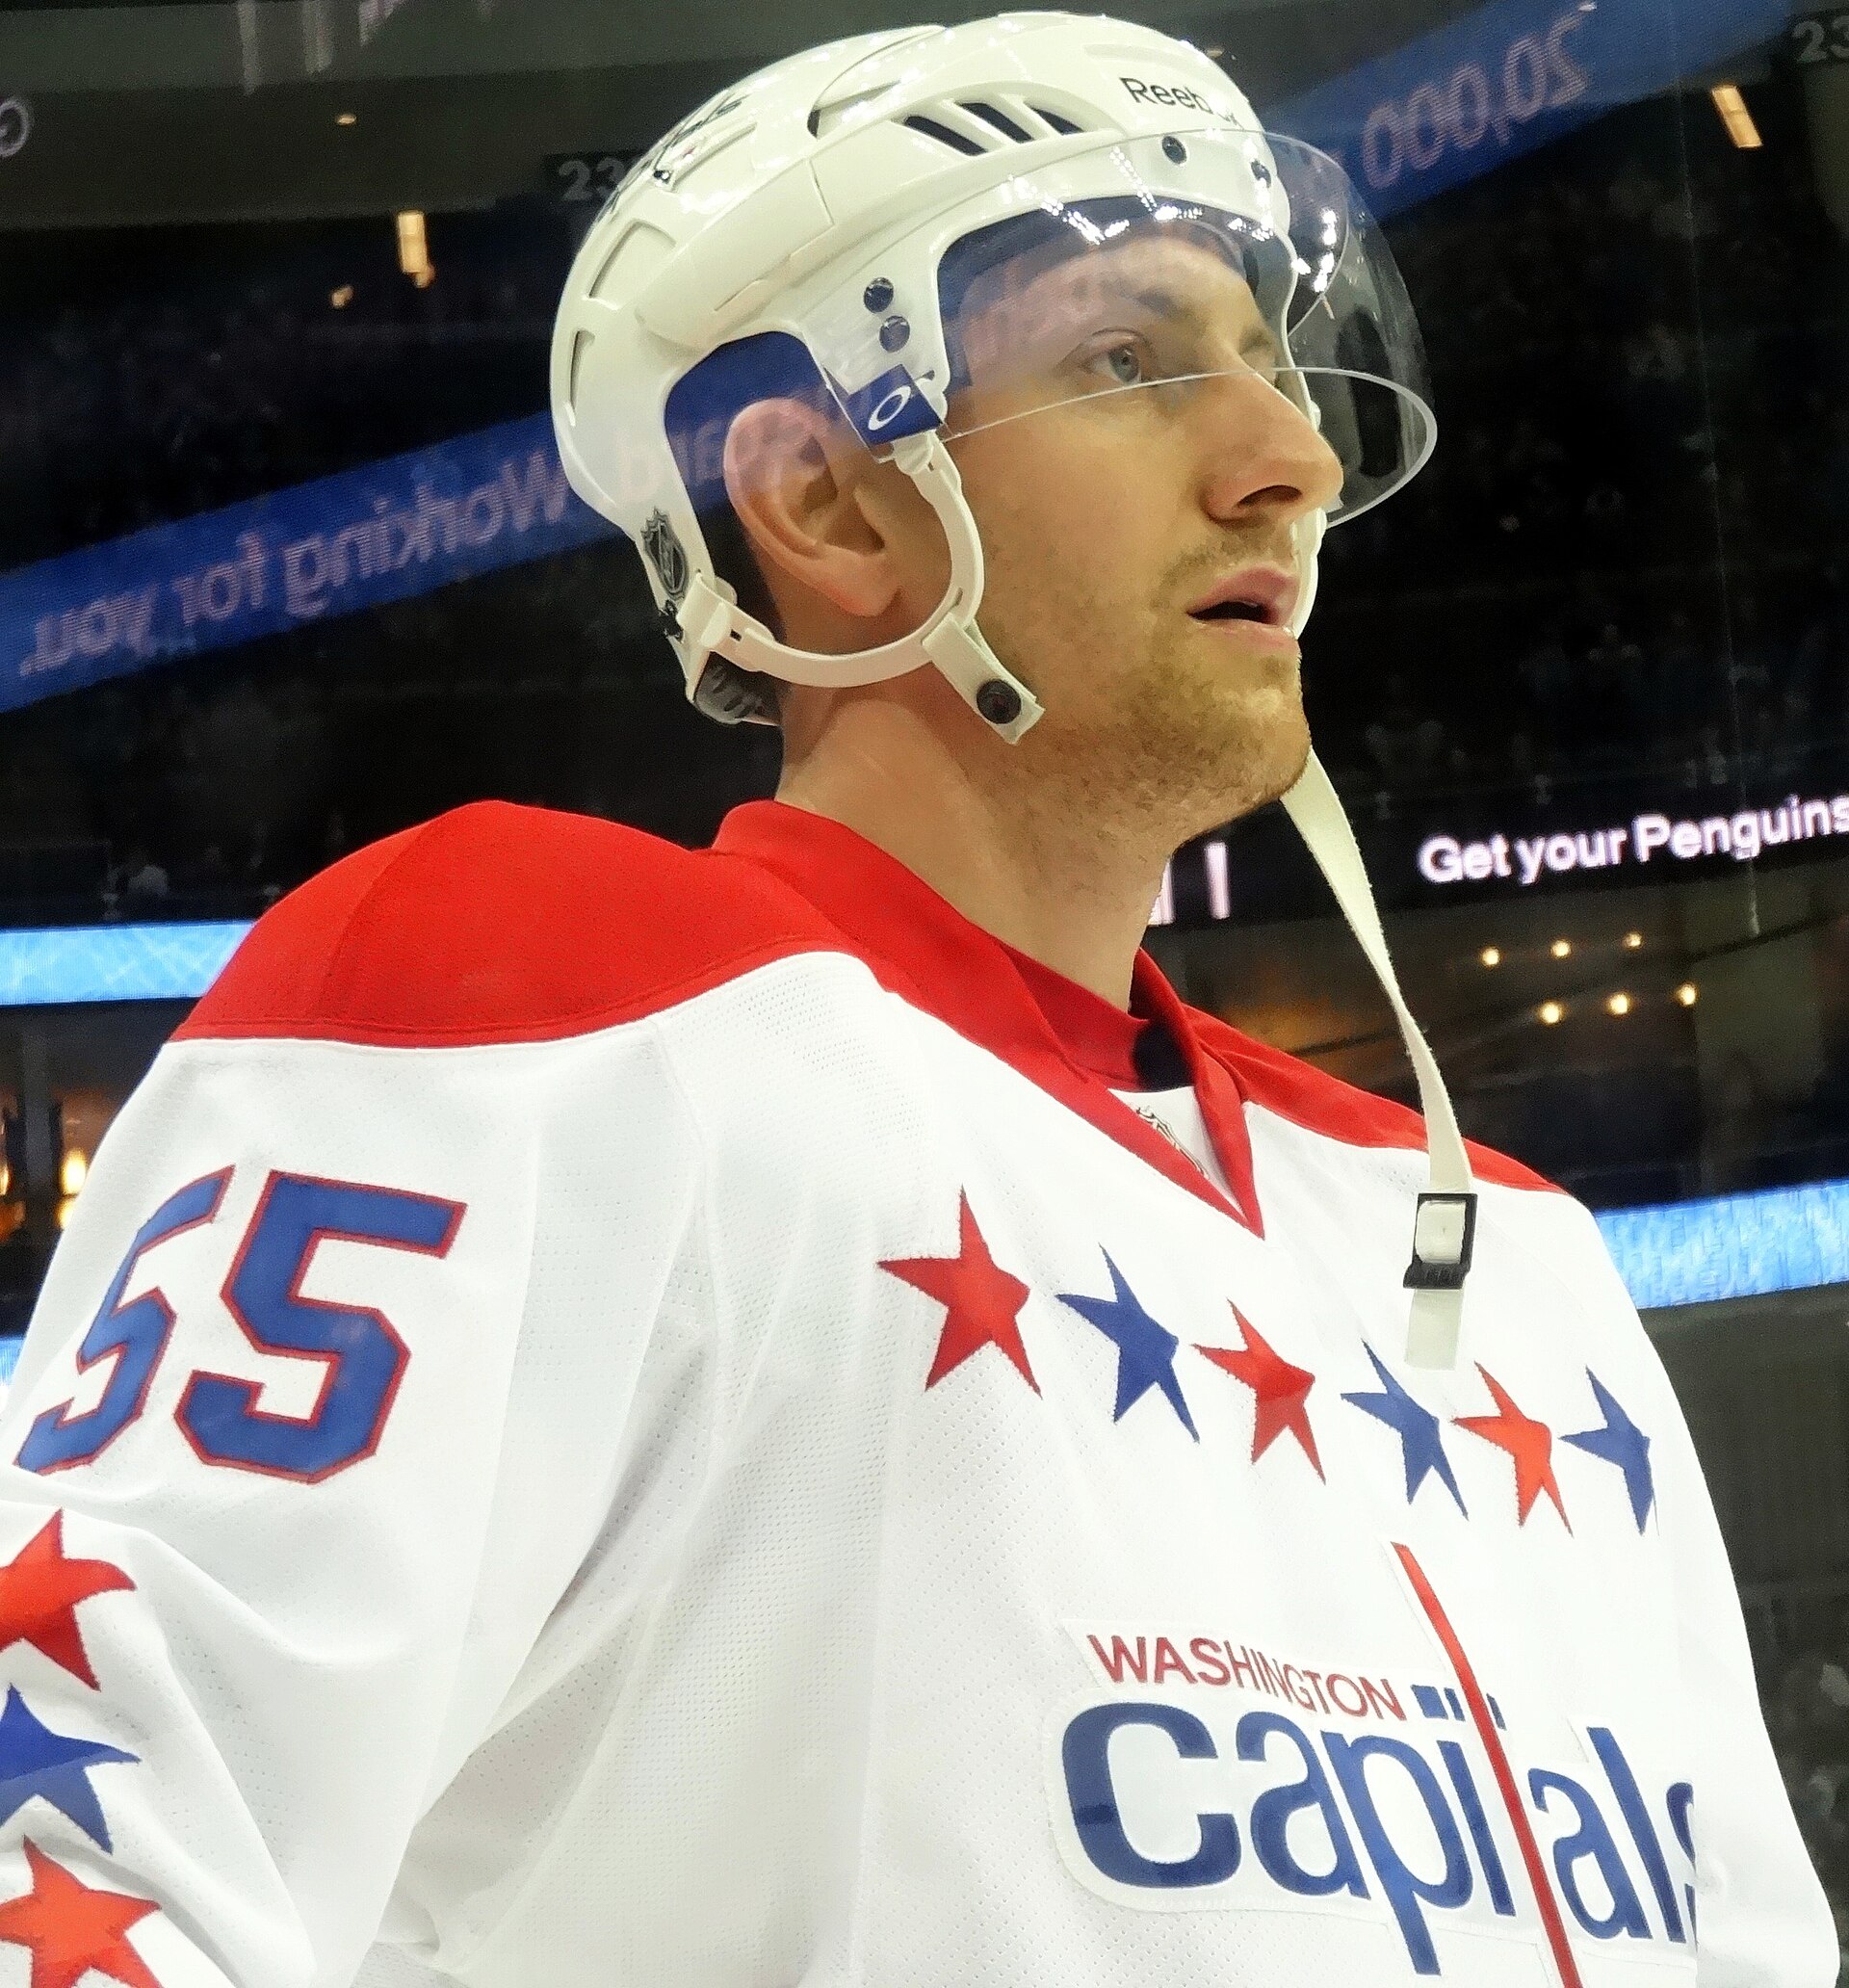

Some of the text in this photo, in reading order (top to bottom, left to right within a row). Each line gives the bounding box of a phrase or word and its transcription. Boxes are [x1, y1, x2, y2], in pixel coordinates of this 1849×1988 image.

[1119, 76, 1244, 131] Reeb
[558, 156, 641, 201] 23
[1418, 794, 1849, 886] Get your Penguins
[13, 1164, 469, 1485] 55
[1086, 1634, 1408, 1722] WASHINGTON
